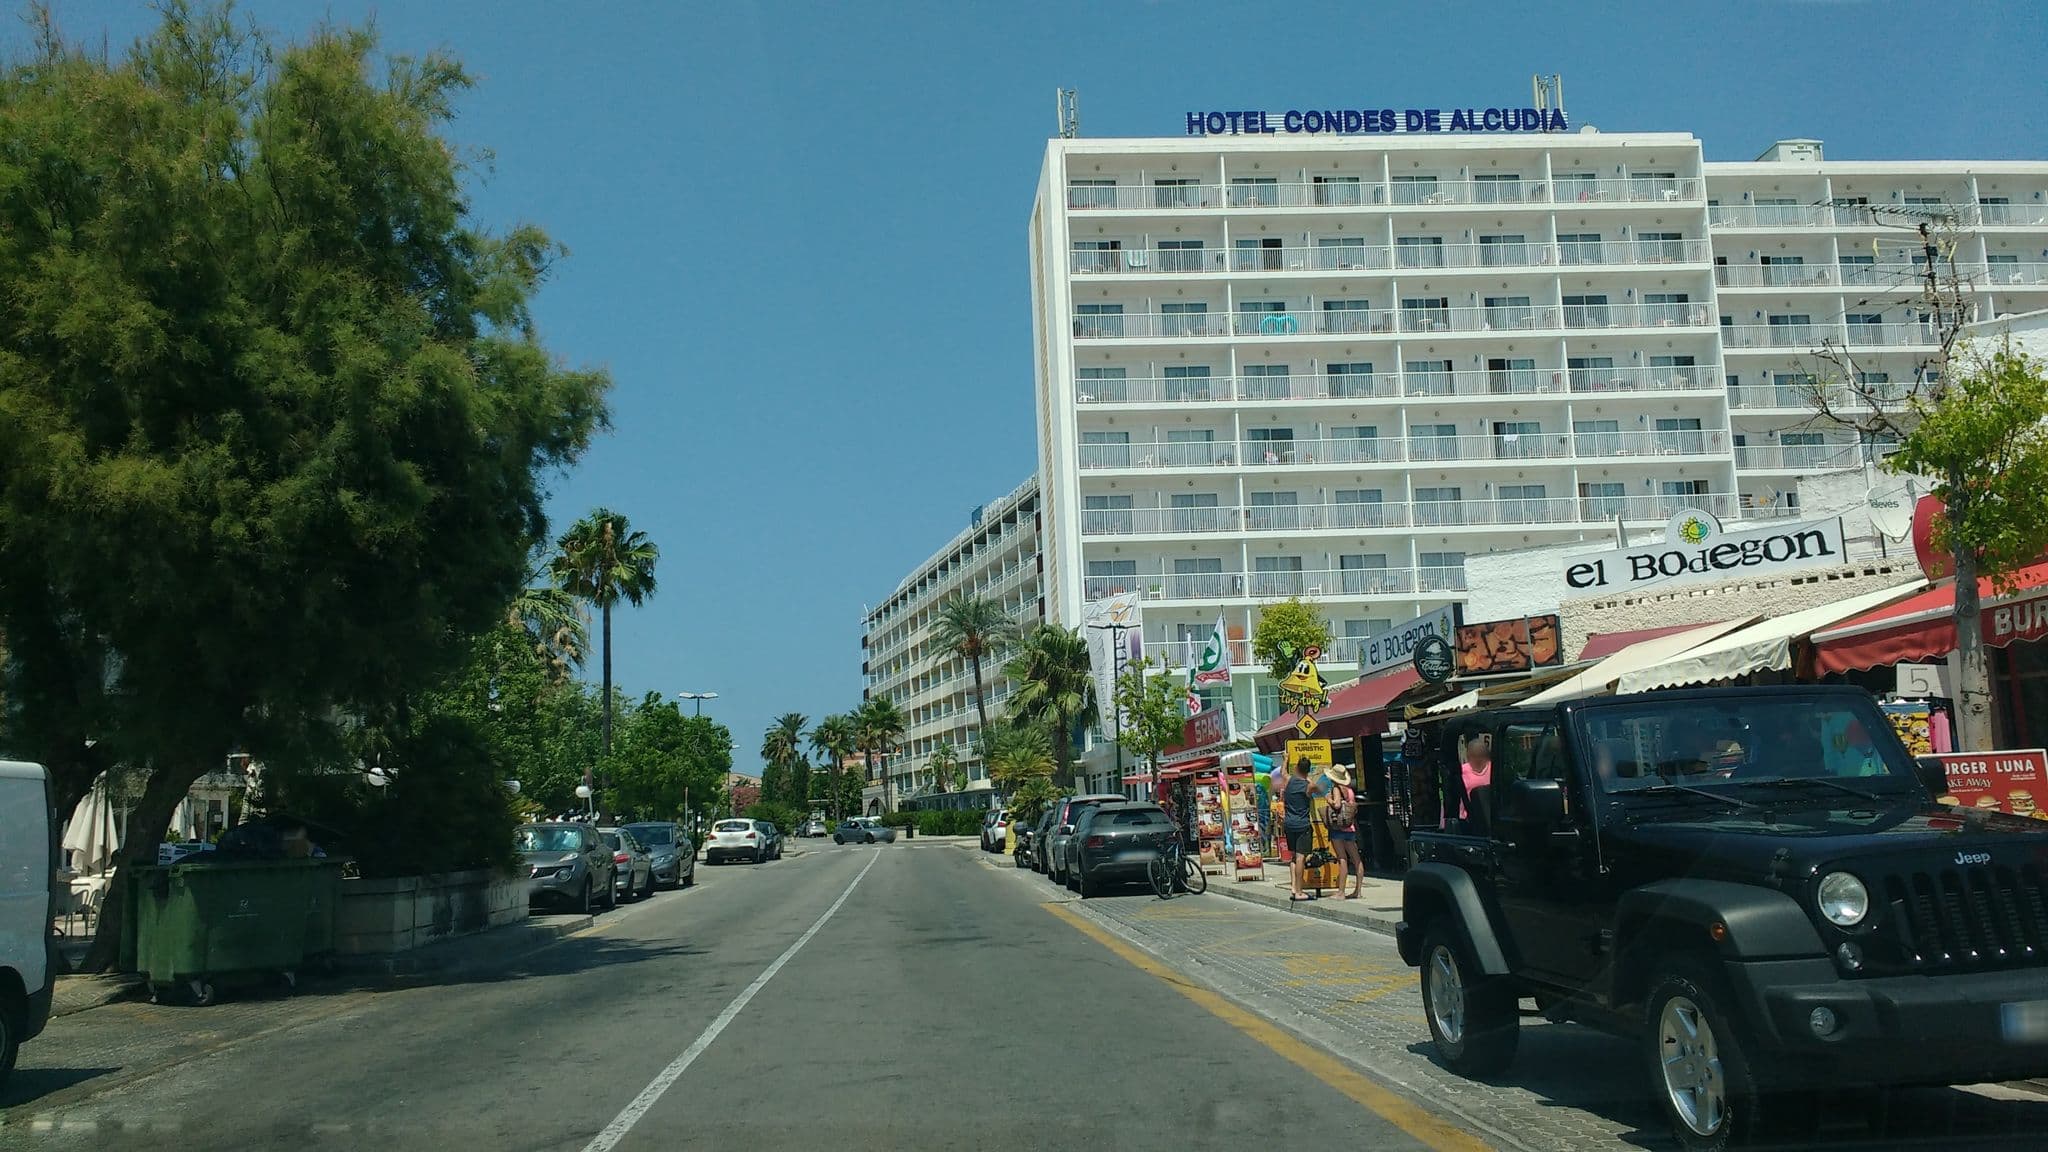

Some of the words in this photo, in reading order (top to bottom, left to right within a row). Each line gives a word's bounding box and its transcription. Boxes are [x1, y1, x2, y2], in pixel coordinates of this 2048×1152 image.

[1187, 111, 1275, 134] HOTEL
[1284, 109, 1397, 133] CONDES
[1405, 109, 1441, 132] DE
[1450, 108, 1568, 132] ALCUDIA
[1566, 559, 1609, 588] el
[1369, 641, 1381, 666] el
[1910, 667, 1929, 693] 5
[1194, 713, 1220, 743] SPAR
[1304, 720, 1311, 729] 6
[1945, 762, 1987, 775] URGER
[1996, 759, 2035, 773] LUNA
[1966, 778, 1992, 787] AWAY
[1954, 851, 1991, 865] Jeep
